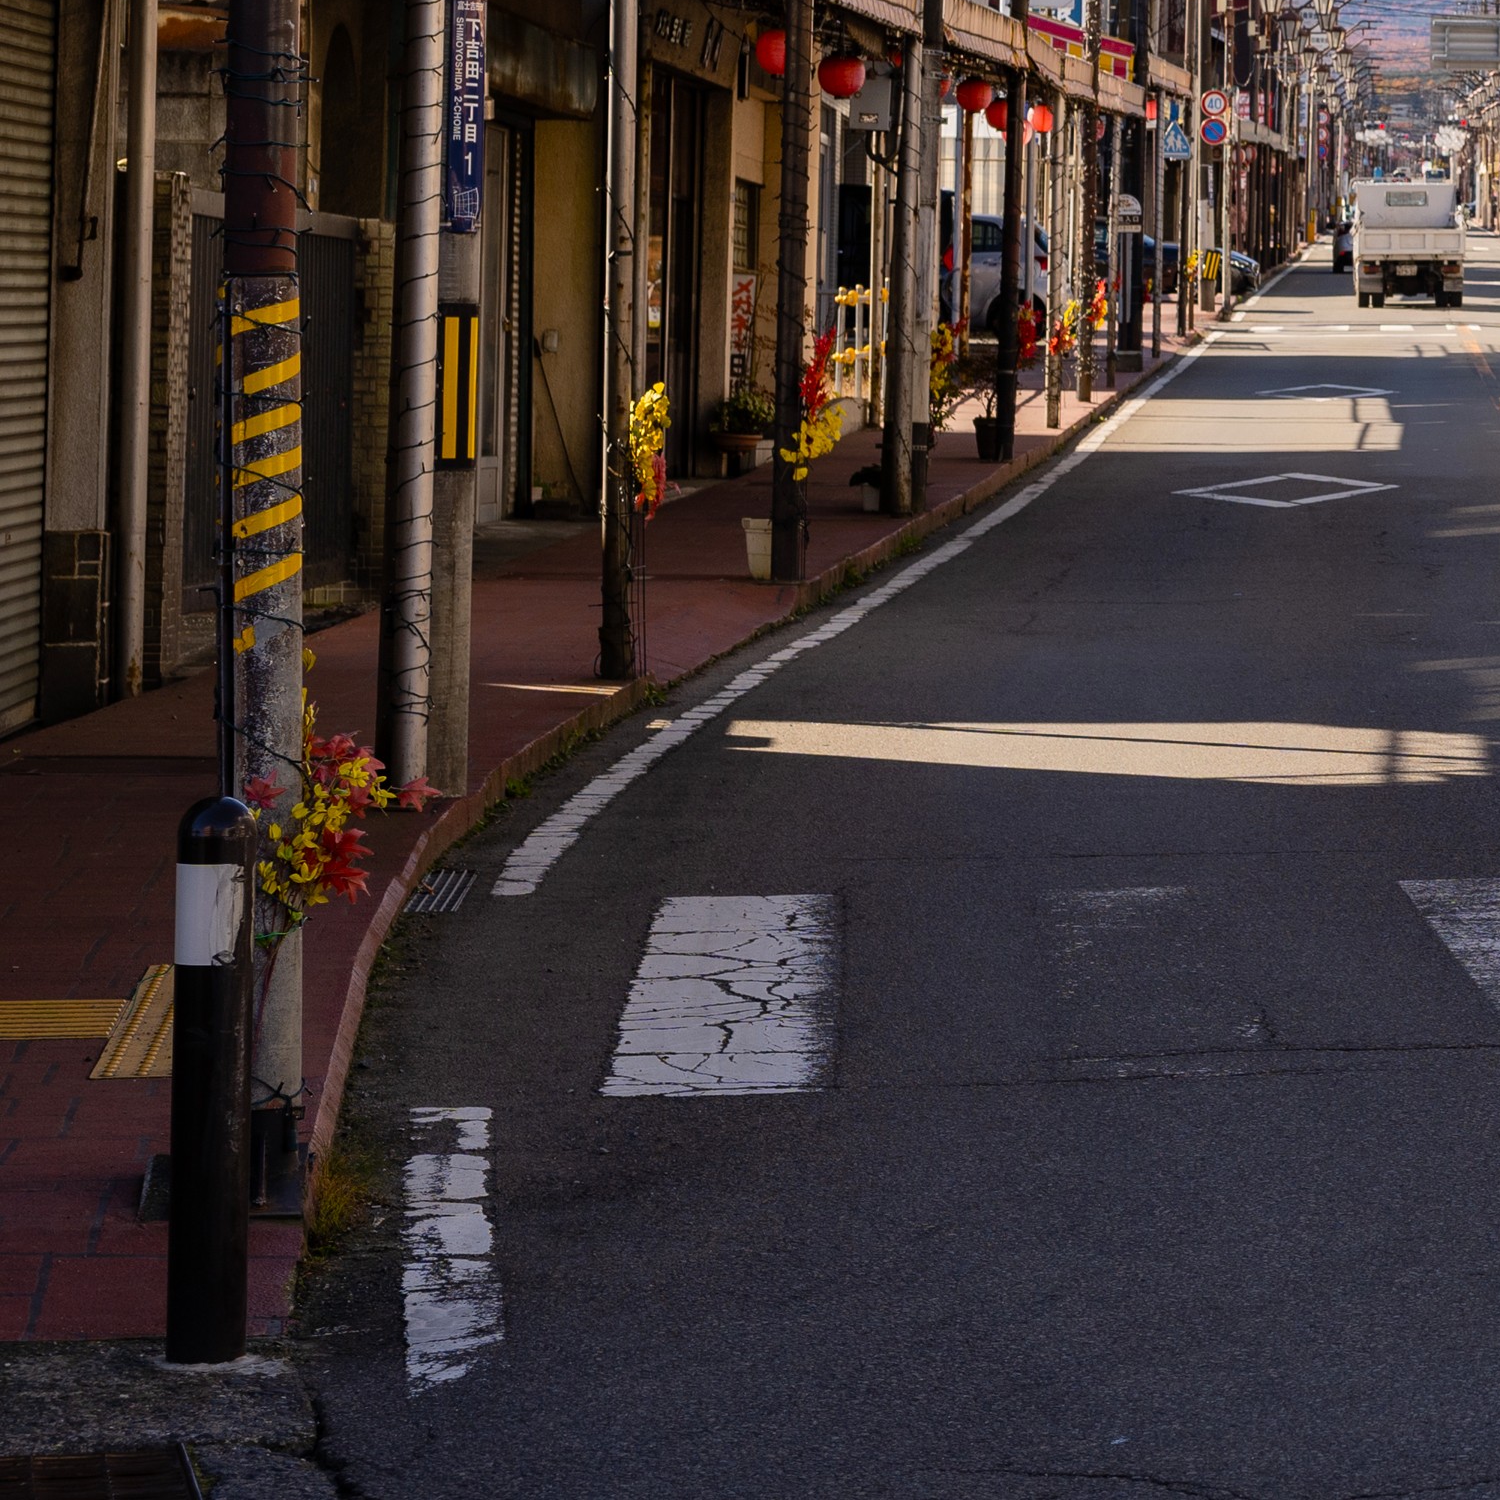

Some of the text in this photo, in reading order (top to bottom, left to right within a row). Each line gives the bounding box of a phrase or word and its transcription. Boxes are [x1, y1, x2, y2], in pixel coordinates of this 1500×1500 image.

[452, 16, 464, 141] SHIMOYOSHIDA 2-CHOME
[463, 18, 480, 176] 下吉田二丁目 1
[1207, 98, 1222, 111] 40
